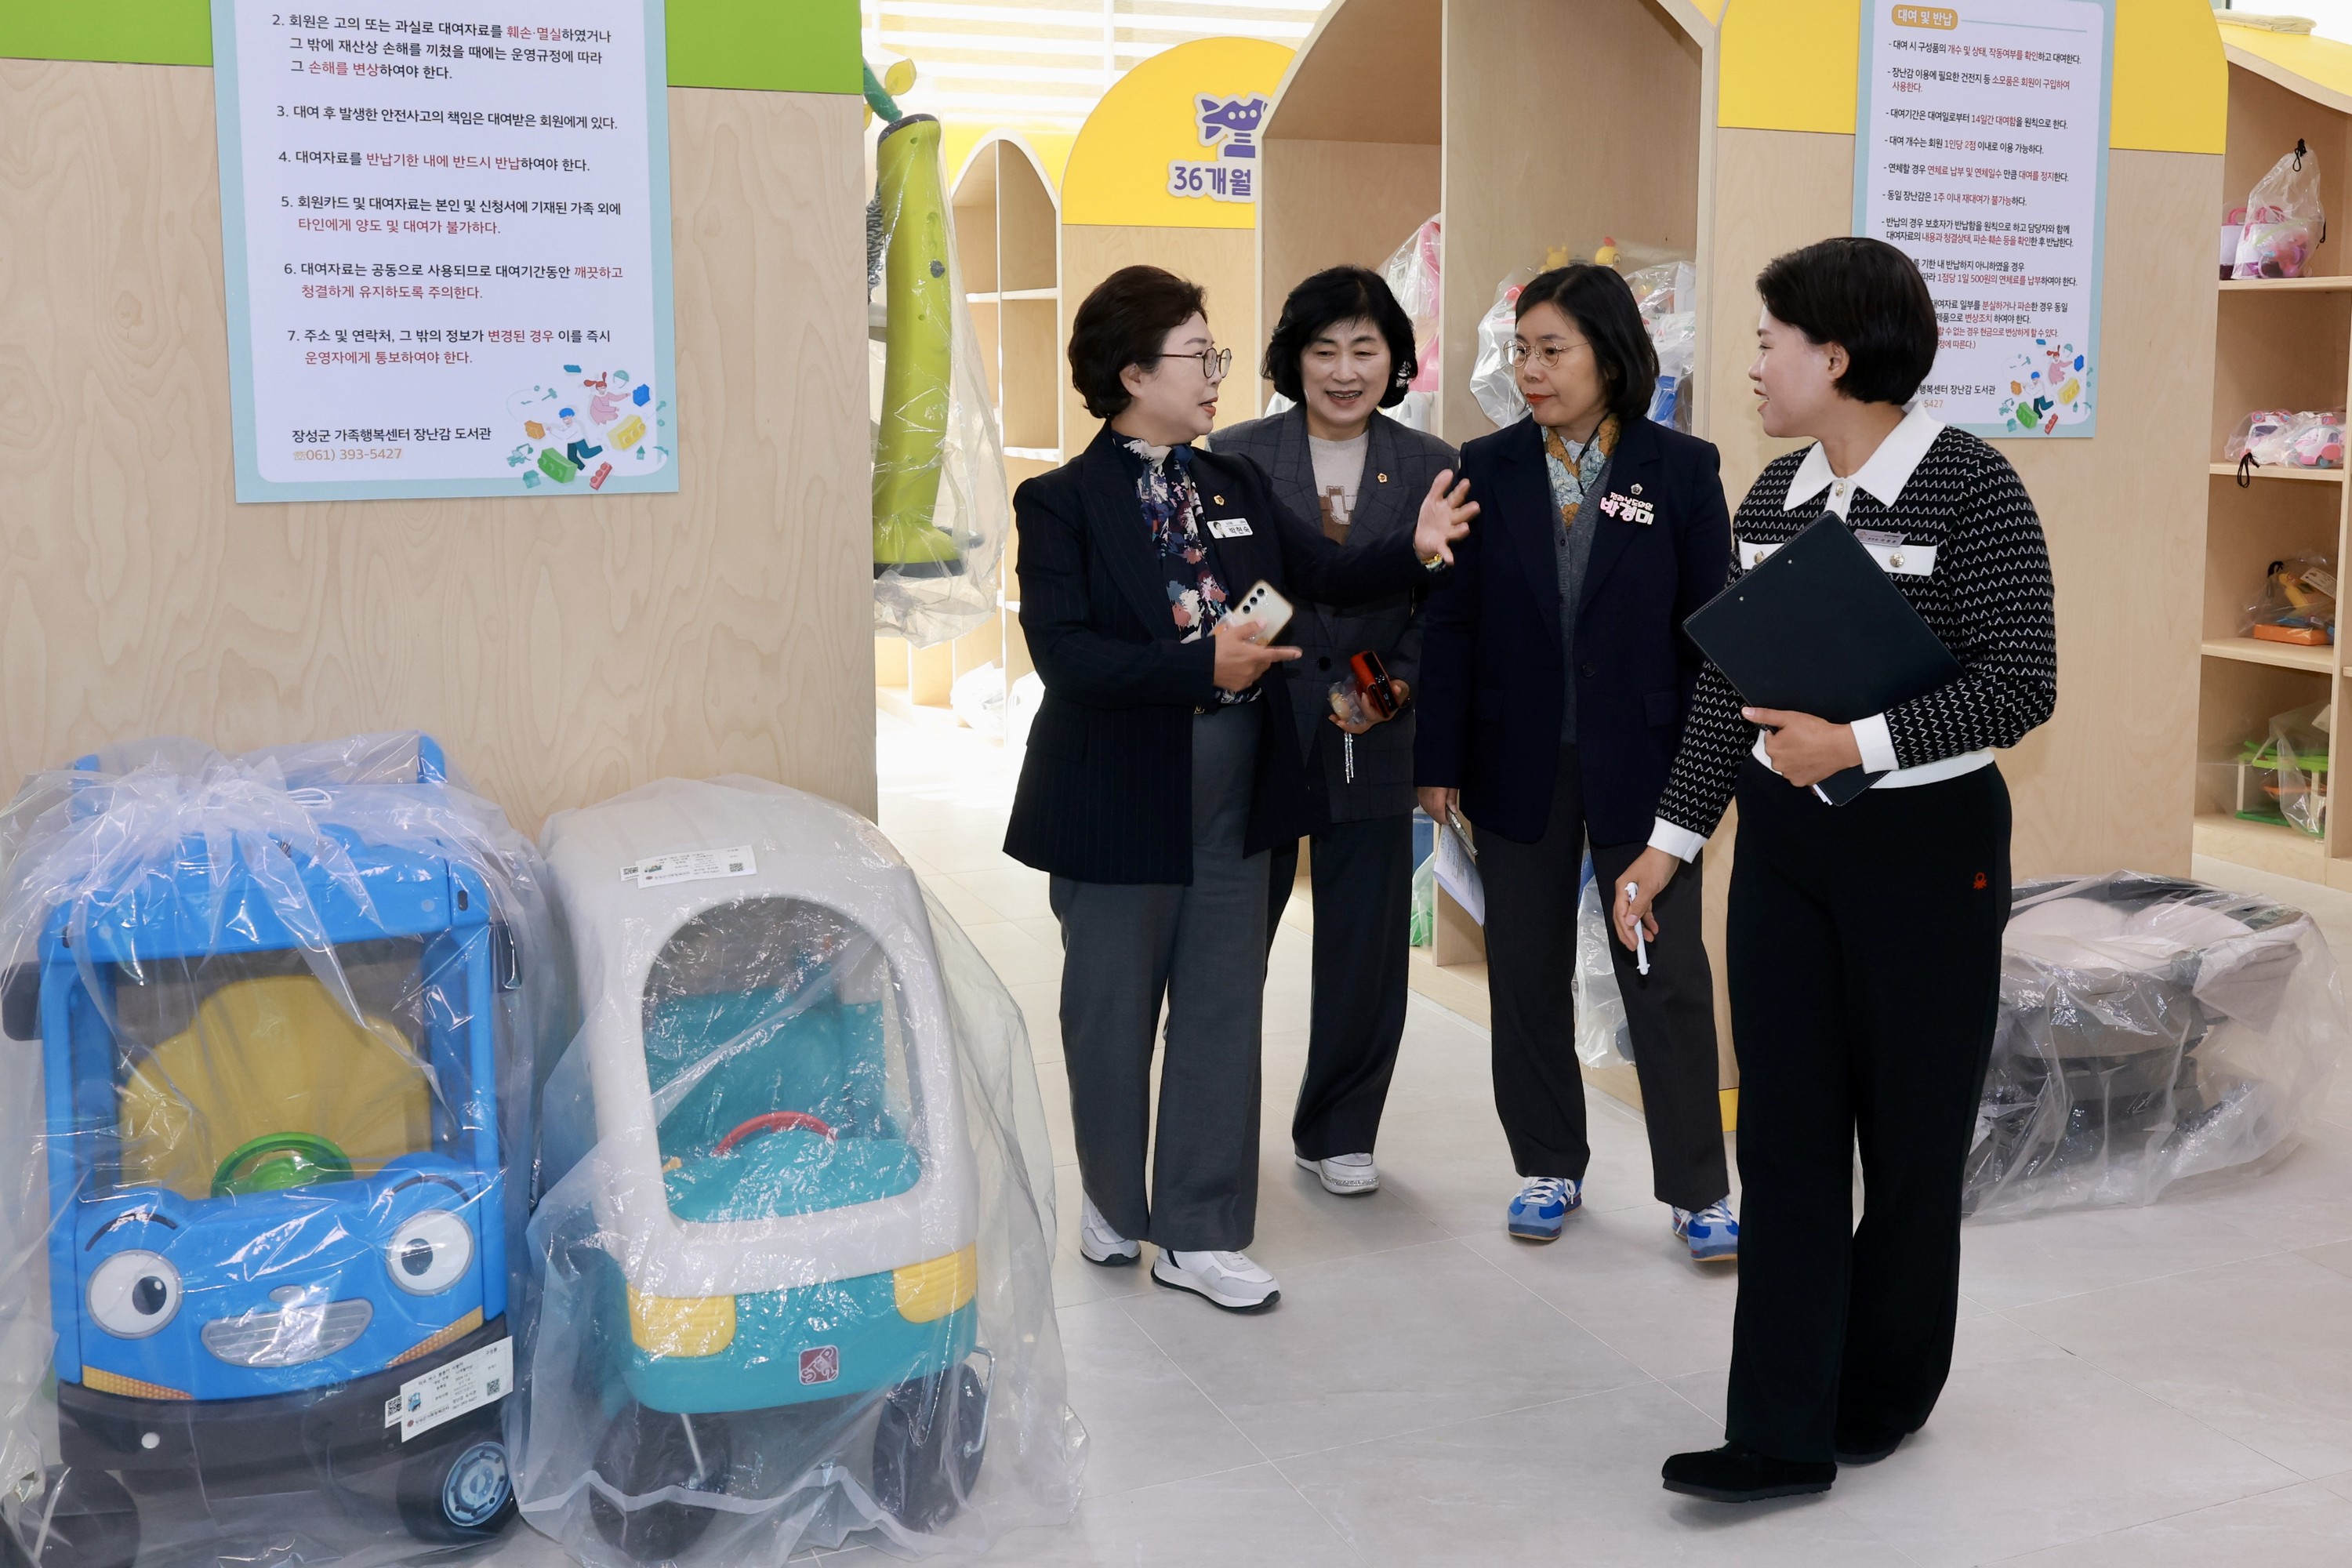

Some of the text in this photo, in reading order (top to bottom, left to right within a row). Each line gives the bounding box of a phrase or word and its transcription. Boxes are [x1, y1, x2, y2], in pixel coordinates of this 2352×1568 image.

[272, 14, 284, 26] 2.
[289, 14, 329, 29] 회원은
[334, 17, 360, 31] 고의
[365, 19, 391, 32] 또는
[395, 20, 434, 34] 과실로
[439, 22, 503, 38] 대여자료를
[1898, 9, 1953, 27] 대여 및 반납
[289, 38, 602, 64] 그 밖에 재산상 손해를 끼쳤을 때에는 운영규정에 따라
[1893, 40, 2081, 64] 대여 시 구성품의 개수 및 상태, 작동여부를 확인하고 대여한다.
[291, 60, 452, 79] 그 손해를 변상하여야 한다.
[1893, 67, 2070, 90] 장난감 이용에 필요한 건전지 등 소모품은 회원이 구입하여
[1893, 81, 1922, 93] 사용한다.
[277, 105, 617, 129] 3. 대여 후 발생한 안전사고의 책임은 대여받은 회원에게 있다.
[1891, 108, 2068, 129] 대여기간은 대여일로부터 14일간 대여함을 원칙으로 한다.
[1889, 136, 2044, 154] 대여 개수는 회원 1인당 2점 이내로 이용 가능하다.
[278, 151, 590, 172] 4. 대여자료를 반납기한 내에 반드시 반납하여야 한다.
[1174, 166, 1251, 196] 36개월
[1889, 163, 2069, 182] 연체할 경우 연체료 납부 및 연체일수 만큼 대여를 정지한다.
[281, 195, 620, 216] 5. 회원카드 및 대여자료는 본인 및 신청서에 기재된 가족 외에
[1888, 190, 2027, 206] 동일 장난감은 1주 이내 재대여가 불가능하다.
[299, 218, 500, 234] 타인에게 양도 및 대여가 불가하다.
[1886, 217, 2070, 234] 반납의 경우 보호자가 반납함을 원칙으로 하고 담당자와 함께
[1886, 230, 1921, 241] 대여자료의
[1922, 232, 1943, 242] 내용과
[1944, 233, 1972, 244] 청결상태,
[2003, 235, 2016, 246] 등을
[2017, 236, 2038, 246] 확인한
[2038, 237, 2045, 247] 후
[2046, 237, 2074, 248] 반납한다.
[285, 263, 623, 279] 6. 대여자료는 공동으로 사용되므로 대여기간동안 깨끗하고
[302, 285, 482, 299] 청결하게 유지하도록 주의한다.
[288, 329, 610, 343] 7. 주소 및 연락처, 그 밖의 정보가 변경된 경우 이를 즉시
[305, 351, 472, 365] 운영자에게 통보하여야 한다.
[292, 427, 492, 443] 장성군 가족행복센터 장난감 도서관
[303, 448, 401, 461] 061) 393-5427
[1600, 497, 1654, 525] 박경미
